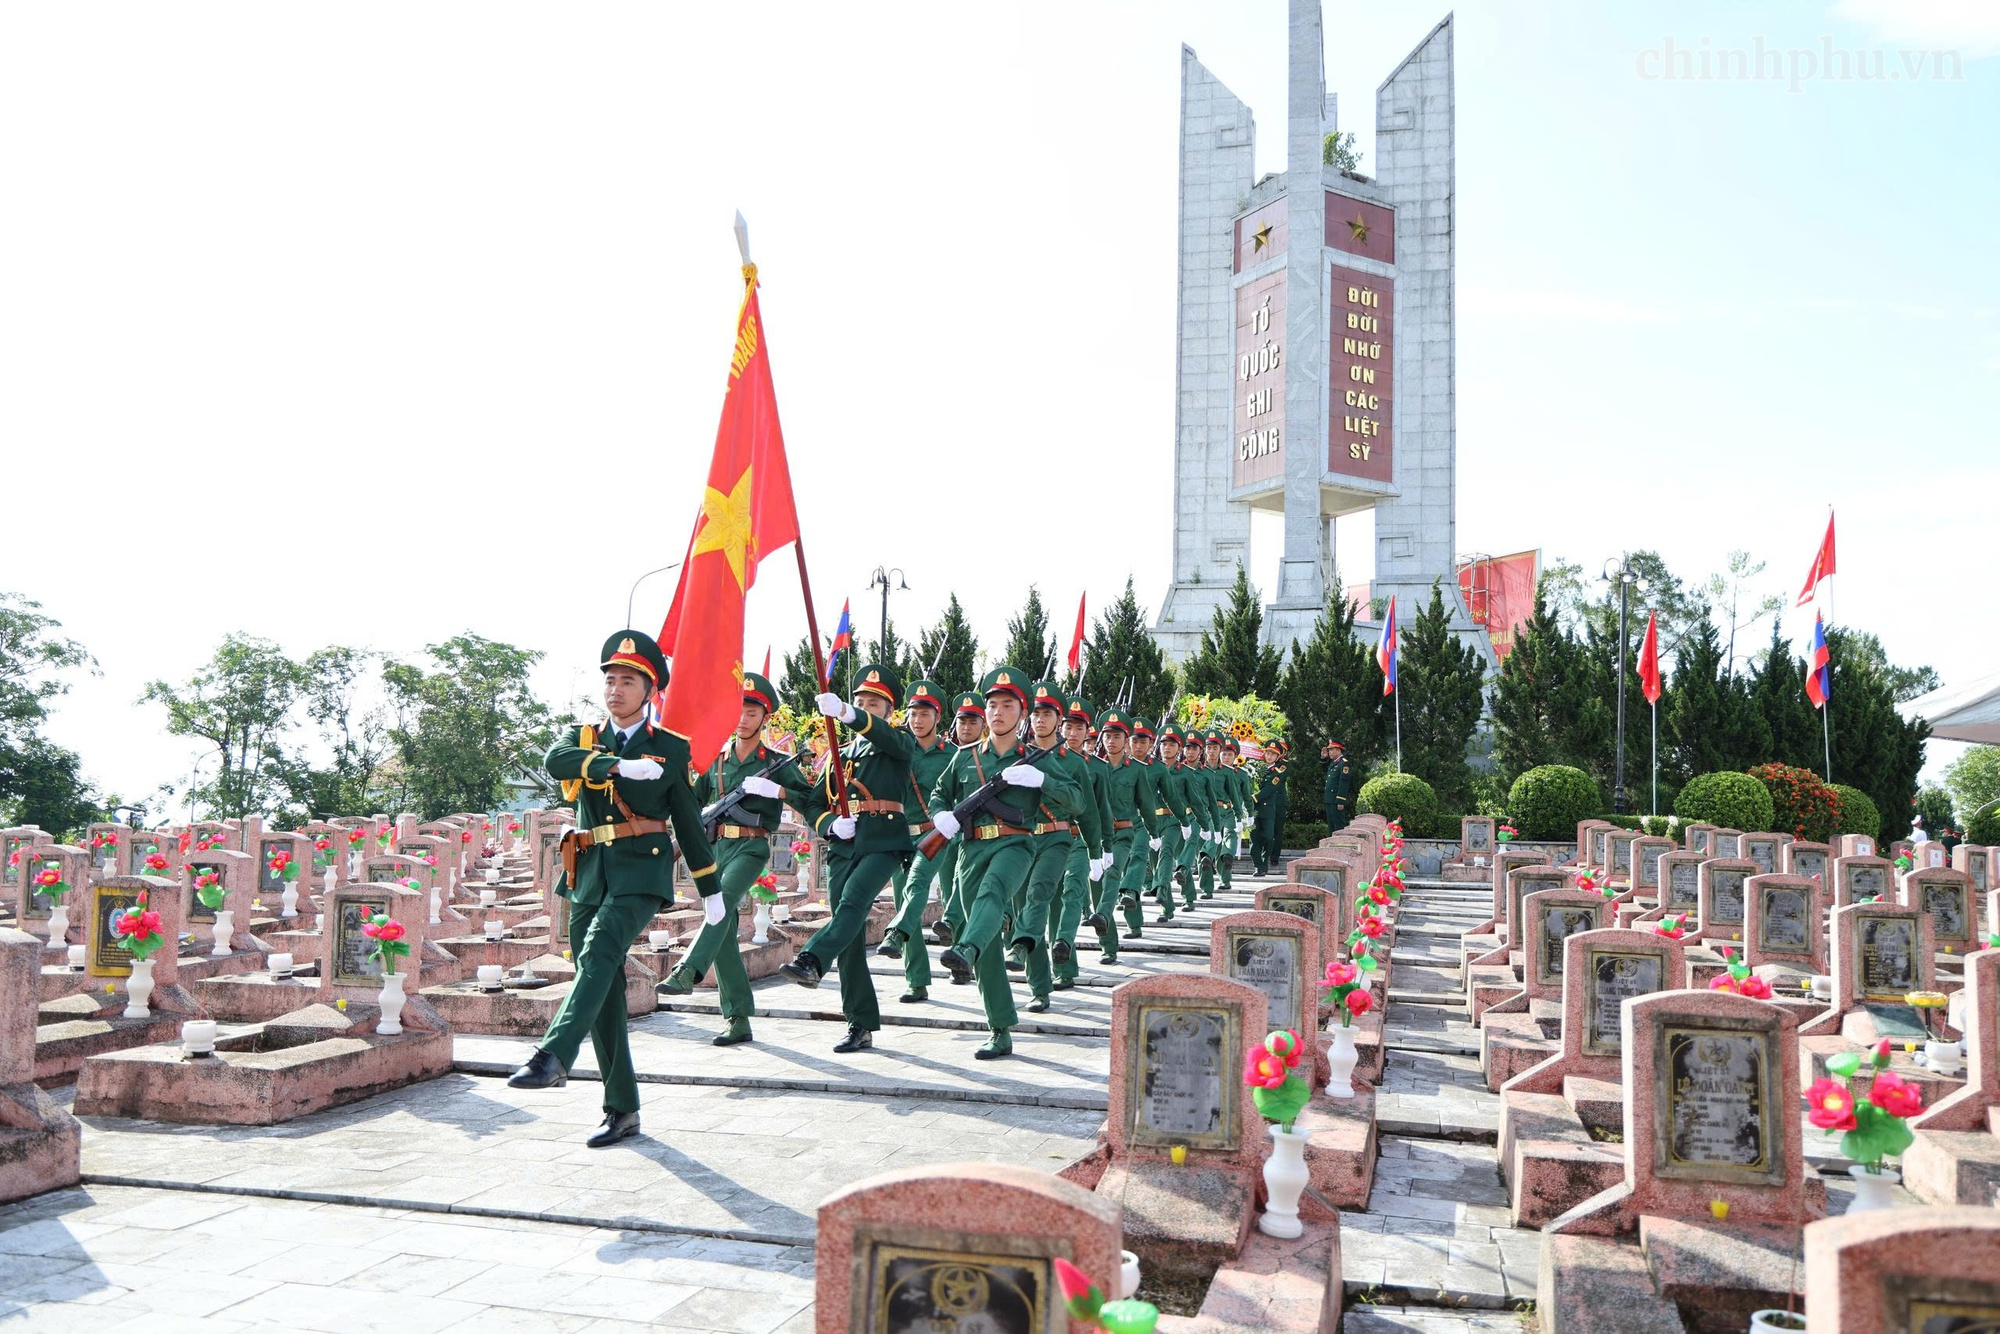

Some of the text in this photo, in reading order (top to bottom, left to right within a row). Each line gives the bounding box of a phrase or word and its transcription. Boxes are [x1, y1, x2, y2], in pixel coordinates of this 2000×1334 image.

[1348, 286, 1378, 308] ĐỜI
[1251, 295, 1271, 335] TỔ
[1347, 313, 1377, 334] ĐỜI
[1240, 339, 1279, 381] QUỐC
[1343, 338, 1381, 360] NHỚ
[1350, 365, 1375, 385] ƠN
[1247, 388, 1272, 418] GHI
[1345, 390, 1379, 410] CÁC
[1344, 415, 1379, 438] LIỆT
[1239, 427, 1279, 462] CÔNG
[1349, 443, 1371, 461] SỸ
